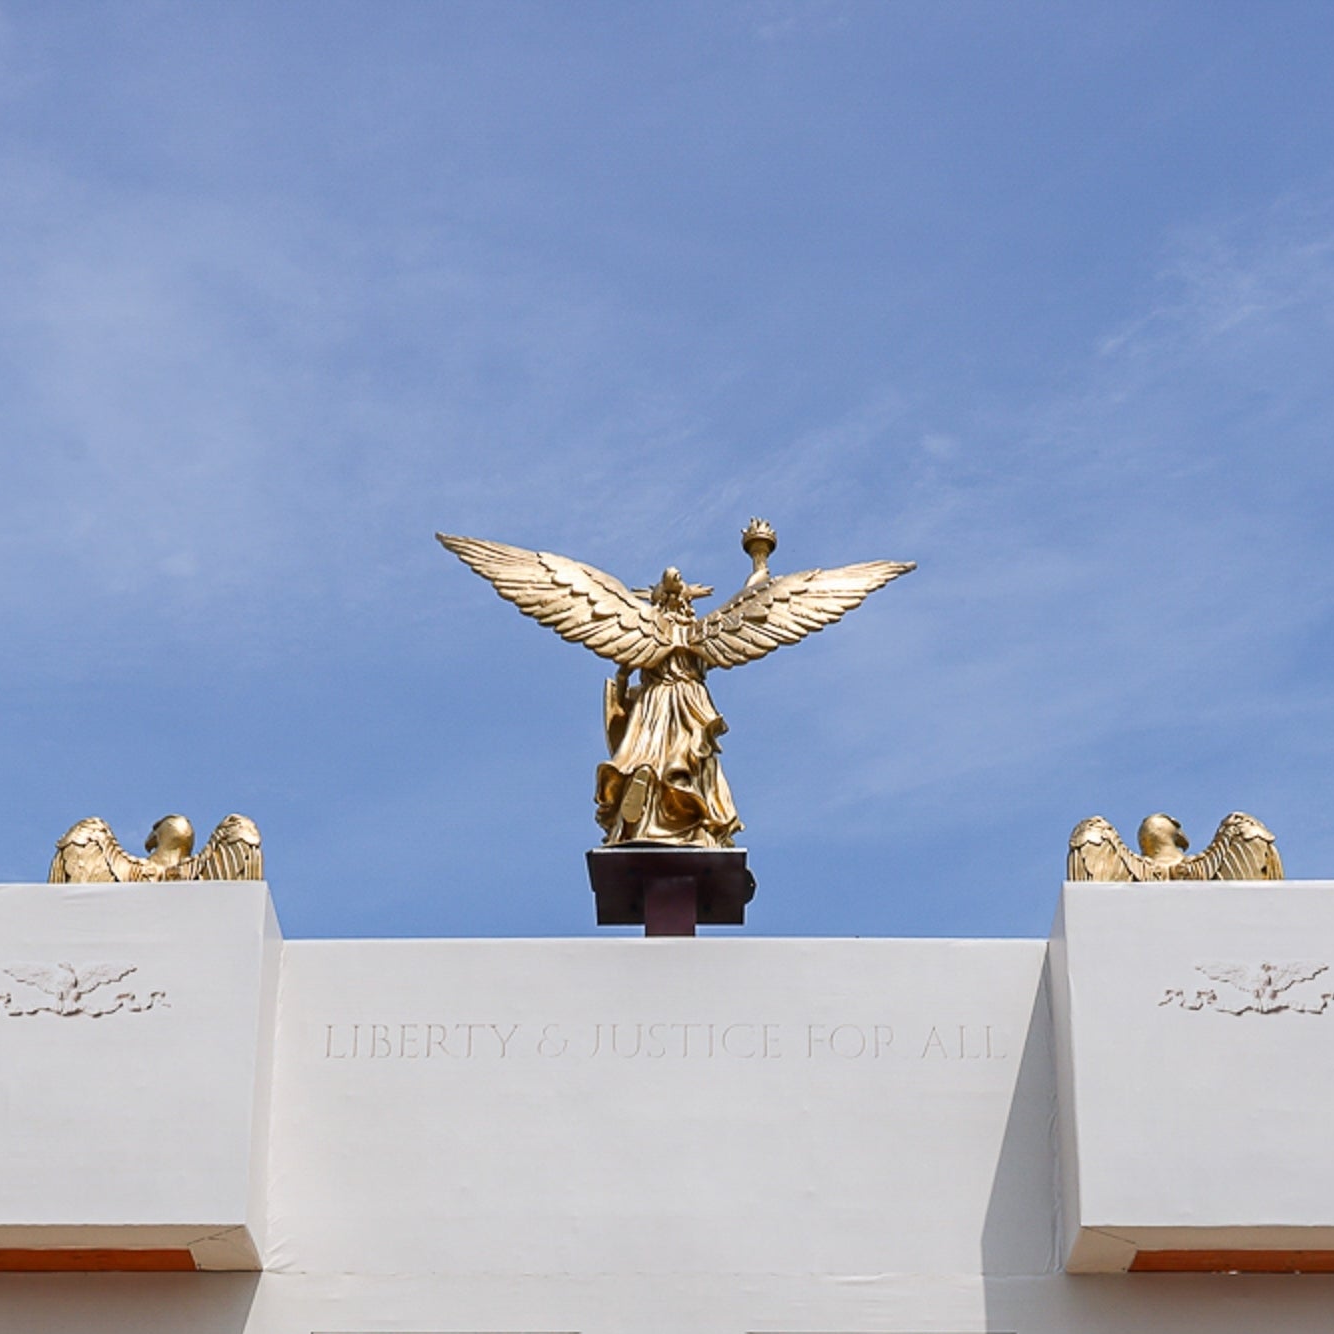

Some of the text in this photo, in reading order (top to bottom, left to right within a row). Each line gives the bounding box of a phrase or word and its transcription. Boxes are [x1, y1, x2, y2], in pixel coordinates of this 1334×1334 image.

[324, 1022, 1010, 1059] LIBERTY & JUSTICE FOR ALL
